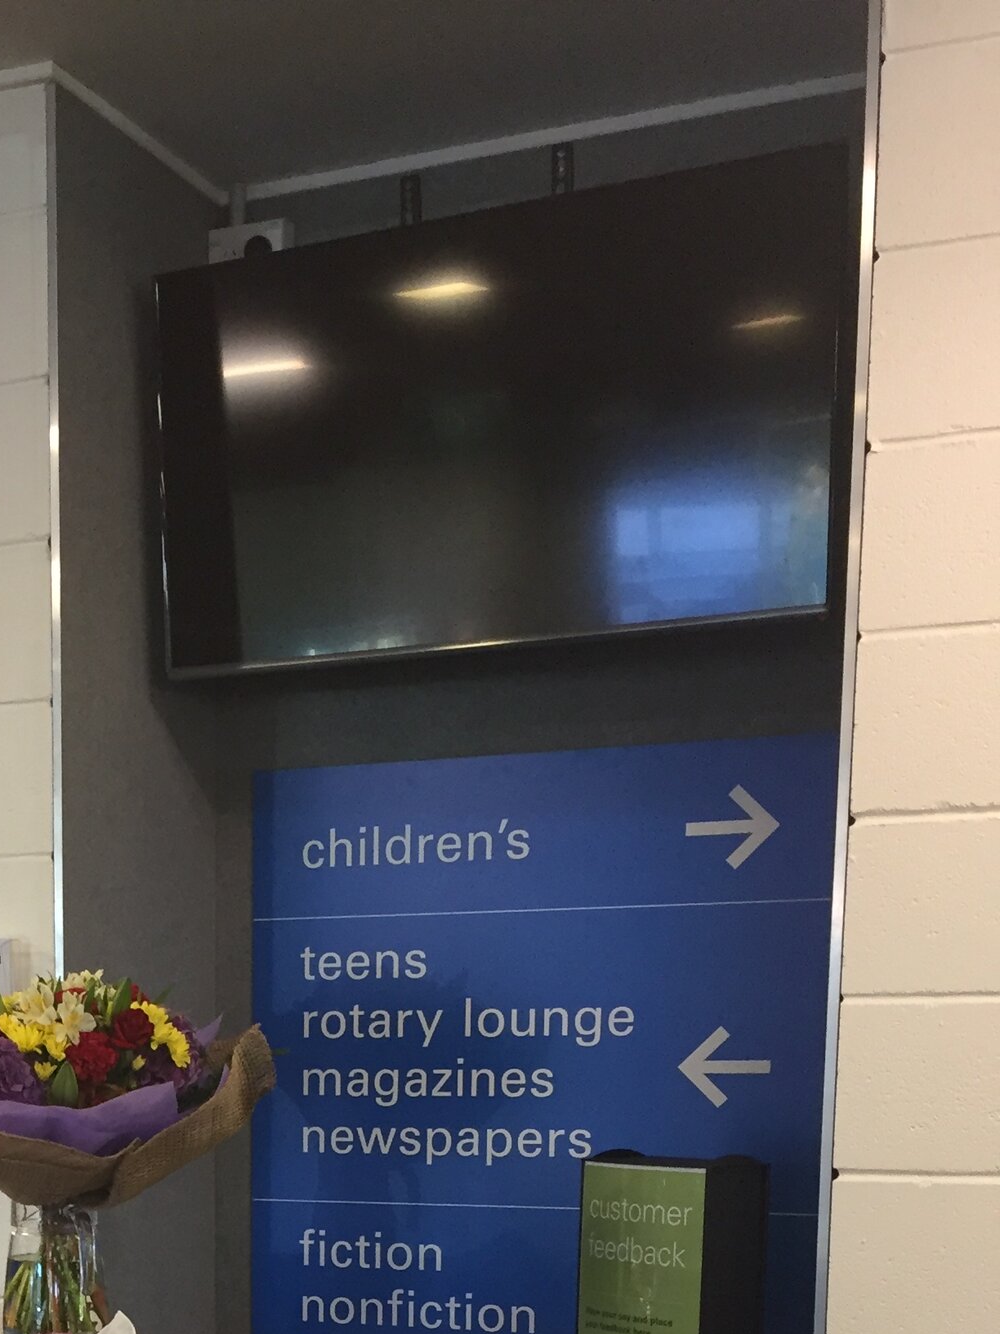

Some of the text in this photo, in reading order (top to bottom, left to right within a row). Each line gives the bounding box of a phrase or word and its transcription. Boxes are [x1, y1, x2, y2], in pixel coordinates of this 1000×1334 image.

[302, 818, 531, 869] children's
[300, 946, 427, 981] teens
[302, 997, 635, 1047] rotary lounge
[302, 1057, 554, 1107] magazines
[302, 1125, 593, 1165] newspapers
[589, 1199, 693, 1227] customer
[299, 1228, 442, 1272] fiction
[588, 1232, 687, 1268] feedback
[302, 1288, 536, 1334] nonfiction
[633, 1315, 648, 1324] and
[650, 1317, 673, 1328] place
